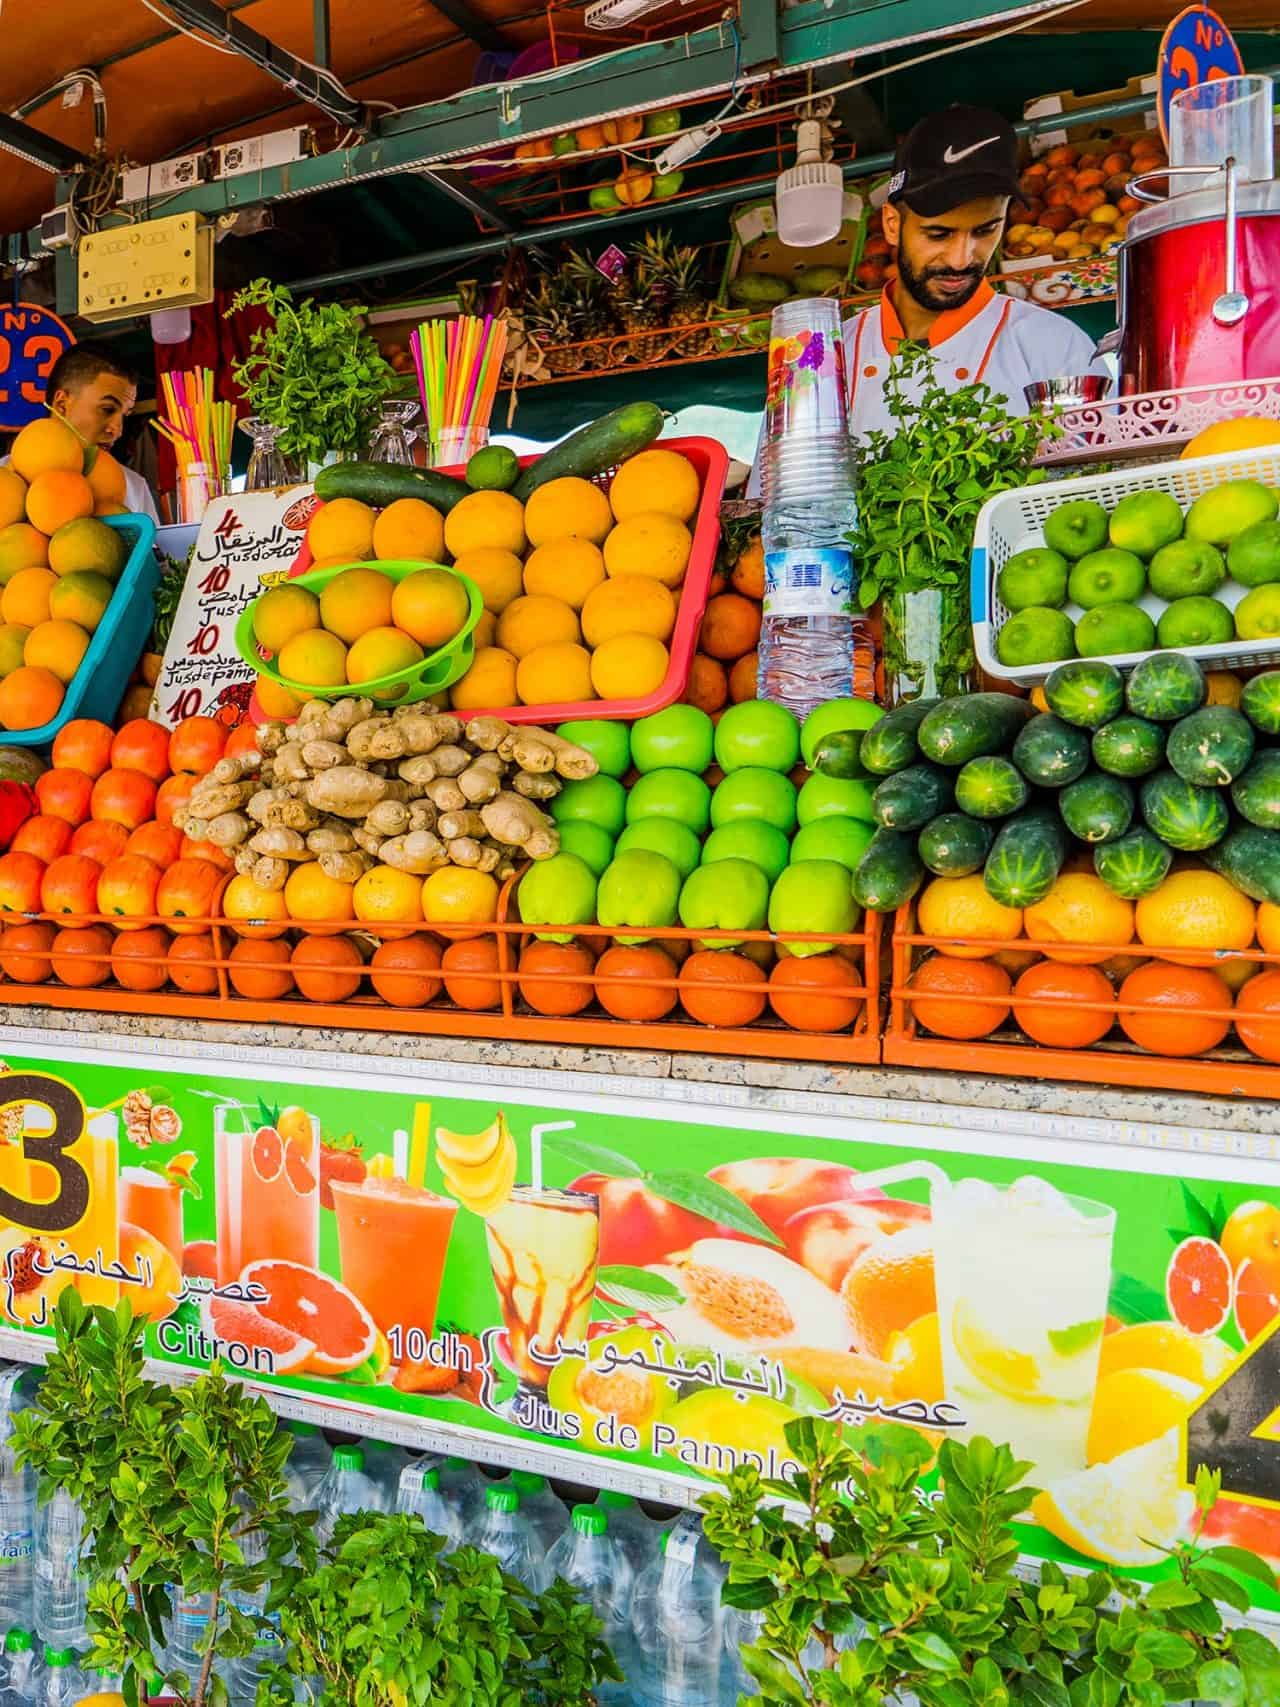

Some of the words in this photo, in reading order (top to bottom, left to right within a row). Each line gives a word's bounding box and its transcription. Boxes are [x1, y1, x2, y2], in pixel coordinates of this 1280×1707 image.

[214, 508, 244, 538] 4
[197, 565, 231, 595] 10
[186, 624, 220, 656] 10
[163, 664, 260, 687] Jusdepamp
[166, 687, 202, 722] 10
[32, 1240, 154, 1288] الحامض
[171, 1279, 272, 1306] عصير
[158, 1321, 275, 1373] Citron
[388, 1325, 471, 1370] 10dh
[521, 1396, 581, 1438] Jus
[596, 1415, 638, 1450] de
[818, 1389, 968, 1426] عصير
